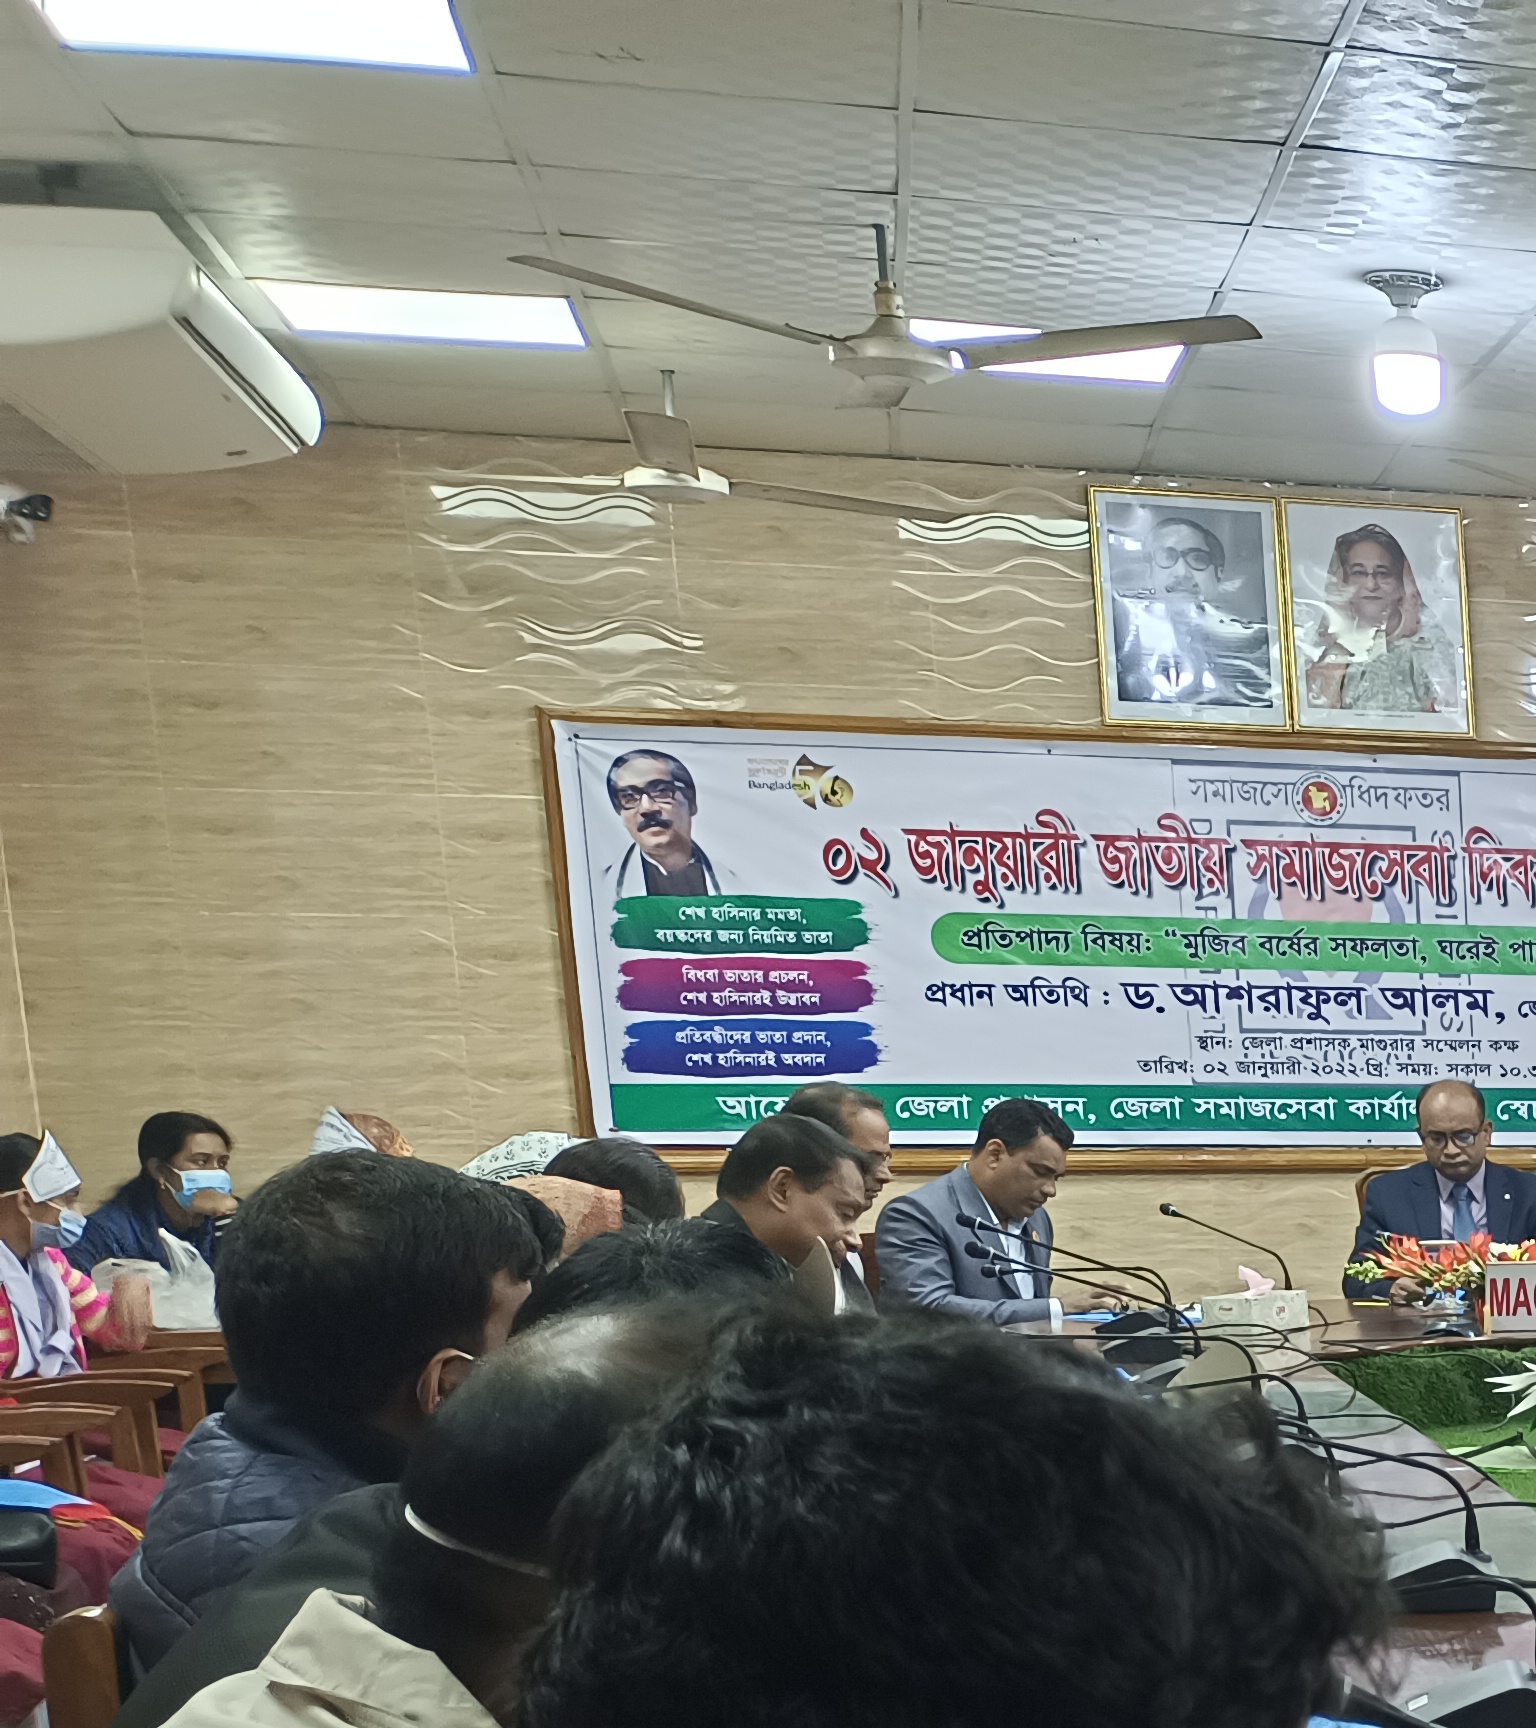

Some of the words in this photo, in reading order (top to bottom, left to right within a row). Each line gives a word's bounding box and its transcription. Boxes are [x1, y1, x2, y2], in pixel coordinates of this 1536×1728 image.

[748, 779, 811, 791] Bangladesh
[1343, 775, 1450, 811] ধিদফতর
[822, 826, 898, 897] ০২
[900, 807, 1083, 906] জানুয়ারী
[1090, 812, 1233, 897] জাতীয়
[1241, 832, 1455, 903] সমাজসেবা
[678, 905, 706, 921] শেখ
[711, 903, 761, 921] হাসিনার
[716, 929, 744, 945] জন্য
[749, 926, 797, 945] নিয়মিত
[801, 930, 833, 945] ভাতা
[960, 921, 1072, 954] প্রতিপাদ্য
[1257, 927, 1320, 957] বর্ষের
[1328, 935, 1428, 965] সফলতা,
[1436, 934, 1501, 965] ঘরেই
[682, 965, 718, 983] বিধবা
[723, 968, 764, 984] ভাতার
[680, 991, 706, 1006] শেখ
[712, 988, 773, 1007] হাসিনারই
[924, 980, 996, 1008] প্রধান
[1003, 976, 1091, 1008] অতিথি
[1378, 983, 1507, 1025] আলম,
[756, 1030, 787, 1044] ভাতা
[1242, 1036, 1284, 1052] জেলা
[1357, 1037, 1416, 1052] মাগুরার
[1488, 1038, 1520, 1053] কক্ষ
[685, 1052, 712, 1067] শেখ
[716, 1049, 777, 1067] হাসিনারই
[780, 1053, 826, 1067] অবদান
[1203, 1060, 1229, 1075] ০২
[1310, 1060, 1360, 1078] ২০২২
[1446, 1062, 1492, 1078] সকাল
[895, 1094, 972, 1120] জেলা
[1109, 1094, 1184, 1121] জেলা
[1191, 1095, 1339, 1122] সমাজসেবা
